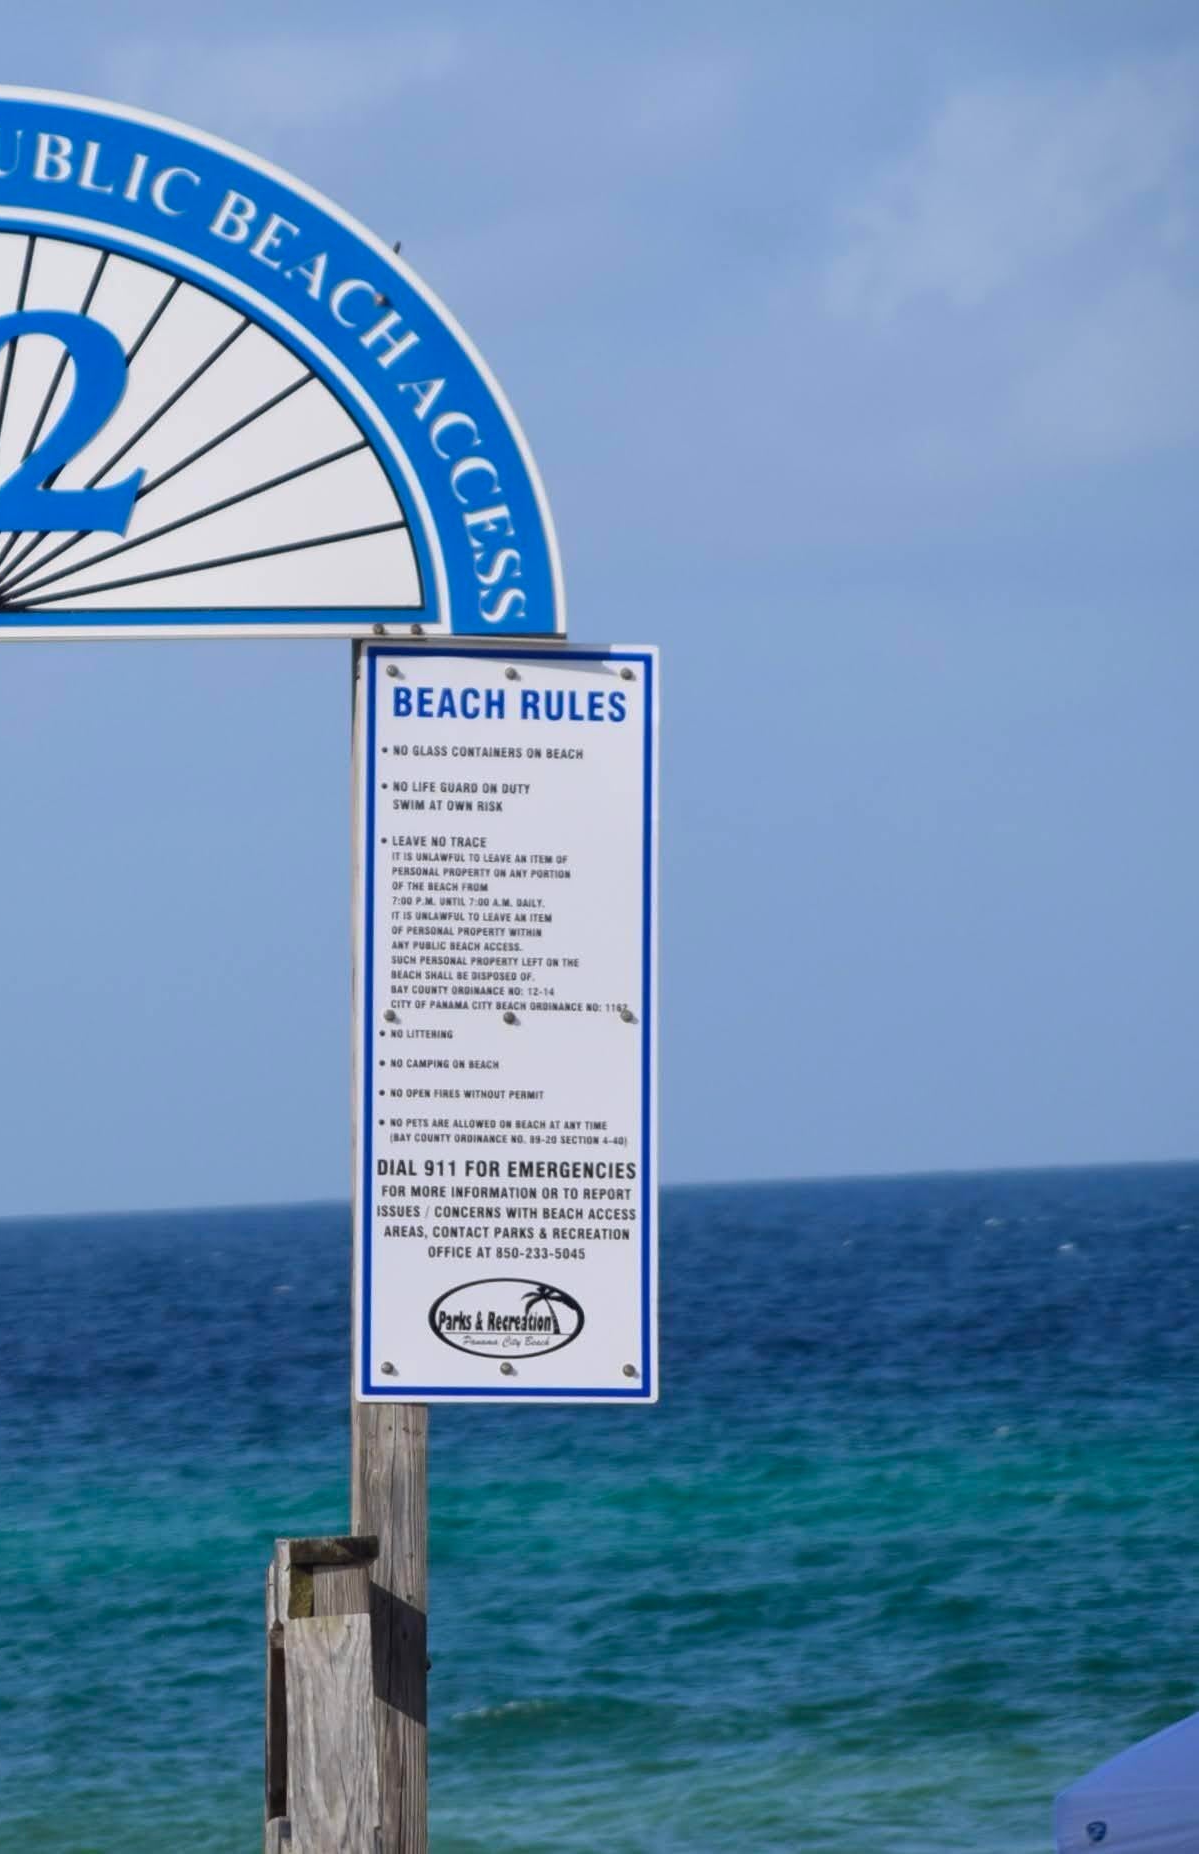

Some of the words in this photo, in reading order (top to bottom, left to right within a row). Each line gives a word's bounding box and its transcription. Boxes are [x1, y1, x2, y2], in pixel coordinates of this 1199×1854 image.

[209, 189, 419, 370] BEACH
[397, 377, 527, 625] ACCESS
[393, 687, 505, 719] BEACH
[521, 689, 627, 722] RULES
[393, 745, 408, 756] NO
[412, 746, 448, 757] GLASS
[452, 746, 523, 758] CONTAINERS
[527, 748, 542, 758] ON
[547, 749, 584, 759] BEACH
[393, 782, 408, 792] NO
[413, 782, 436, 793] LIFE
[440, 782, 478, 793] GUARD
[482, 783, 497, 794] ON
[502, 784, 530, 794] DUTY
[393, 800, 425, 811] SWIM
[429, 800, 443, 811] AT
[447, 801, 473, 811] OWN
[477, 802, 503, 812] RISK
[393, 836, 427, 846] LEAVE
[431, 836, 446, 847] NO
[451, 837, 487, 848] TRACE
[392, 882, 403, 890] OF
[408, 882, 424, 890] THE
[428, 882, 458, 891] BEACH
[462, 883, 488, 892] FROM
[393, 896, 412, 905] 7:00
[416, 897, 436, 906] P.M.
[439, 897, 465, 906] UNTIL
[470, 898, 489, 906] 7:00
[493, 898, 513, 907] A.M.
[517, 898, 545, 908] DAILY.
[392, 942, 409, 950] ANY
[413, 942, 446, 950] PUBLIC
[450, 942, 480, 951] BEACH
[484, 942, 522, 951] ACCESS.
[391, 985, 408, 994] BAY
[412, 985, 448, 994] COUNTY
[452, 986, 504, 995] ORDINANCE
[509, 987, 523, 996] NO:
[528, 988, 555, 996] 12-14
[391, 1030, 403, 1038] NO
[407, 1030, 453, 1039] LITTERING
[391, 1059, 403, 1068] NO
[407, 1059, 449, 1068] CAMPING
[453, 1060, 465, 1068] ON
[469, 1060, 499, 1069] BEACH
[391, 1088, 402, 1097] NO
[406, 1088, 431, 1098] OPEN
[434, 1089, 460, 1098] FIRES
[464, 1090, 506, 1099] WITHOUT
[509, 1090, 544, 1099] PERMIT
[391, 1118, 402, 1127] NO
[406, 1118, 429, 1128] PETS
[432, 1119, 450, 1128] ARE
[453, 1120, 496, 1128] ALLOWED
[500, 1120, 512, 1129] ON
[515, 1120, 546, 1129] BEACH
[549, 1120, 560, 1129] AT
[564, 1121, 582, 1130] ANY
[585, 1121, 607, 1130] TIME
[377, 1159, 417, 1176] DIAL
[424, 1160, 456, 1177] 911
[465, 1160, 500, 1178] FOR
[507, 1161, 636, 1179] EMERGENCIES
[381, 1185, 406, 1197] FOR
[411, 1186, 446, 1198] MORE
[451, 1186, 537, 1199] INFORMATION
[542, 1188, 558, 1199] OR
[563, 1188, 579, 1200] TO
[583, 1188, 631, 1200] REPORT
[377, 1205, 420, 1217] ISSUES
[425, 1206, 430, 1218] /
[434, 1206, 501, 1219] CONCERNS
[506, 1208, 538, 1219] WITH
[543, 1208, 583, 1220] BEACH
[588, 1208, 636, 1221] ACCESS
[384, 1226, 428, 1239] AREAS,
[432, 1226, 489, 1239] CONTACT
[494, 1228, 534, 1239] PARKS
[539, 1228, 548, 1240] &
[553, 1228, 630, 1241] RECREATION
[428, 1246, 472, 1259] OFFICE
[477, 1246, 491, 1259] AT
[496, 1247, 586, 1260] 850-233-5045
[439, 1310, 472, 1331] Parks
[475, 1311, 484, 1331] &
[487, 1311, 552, 1332] Recreation
[463, 1336, 498, 1345] Panama
[502, 1336, 522, 1348] City
[525, 1336, 550, 1346] Beach
